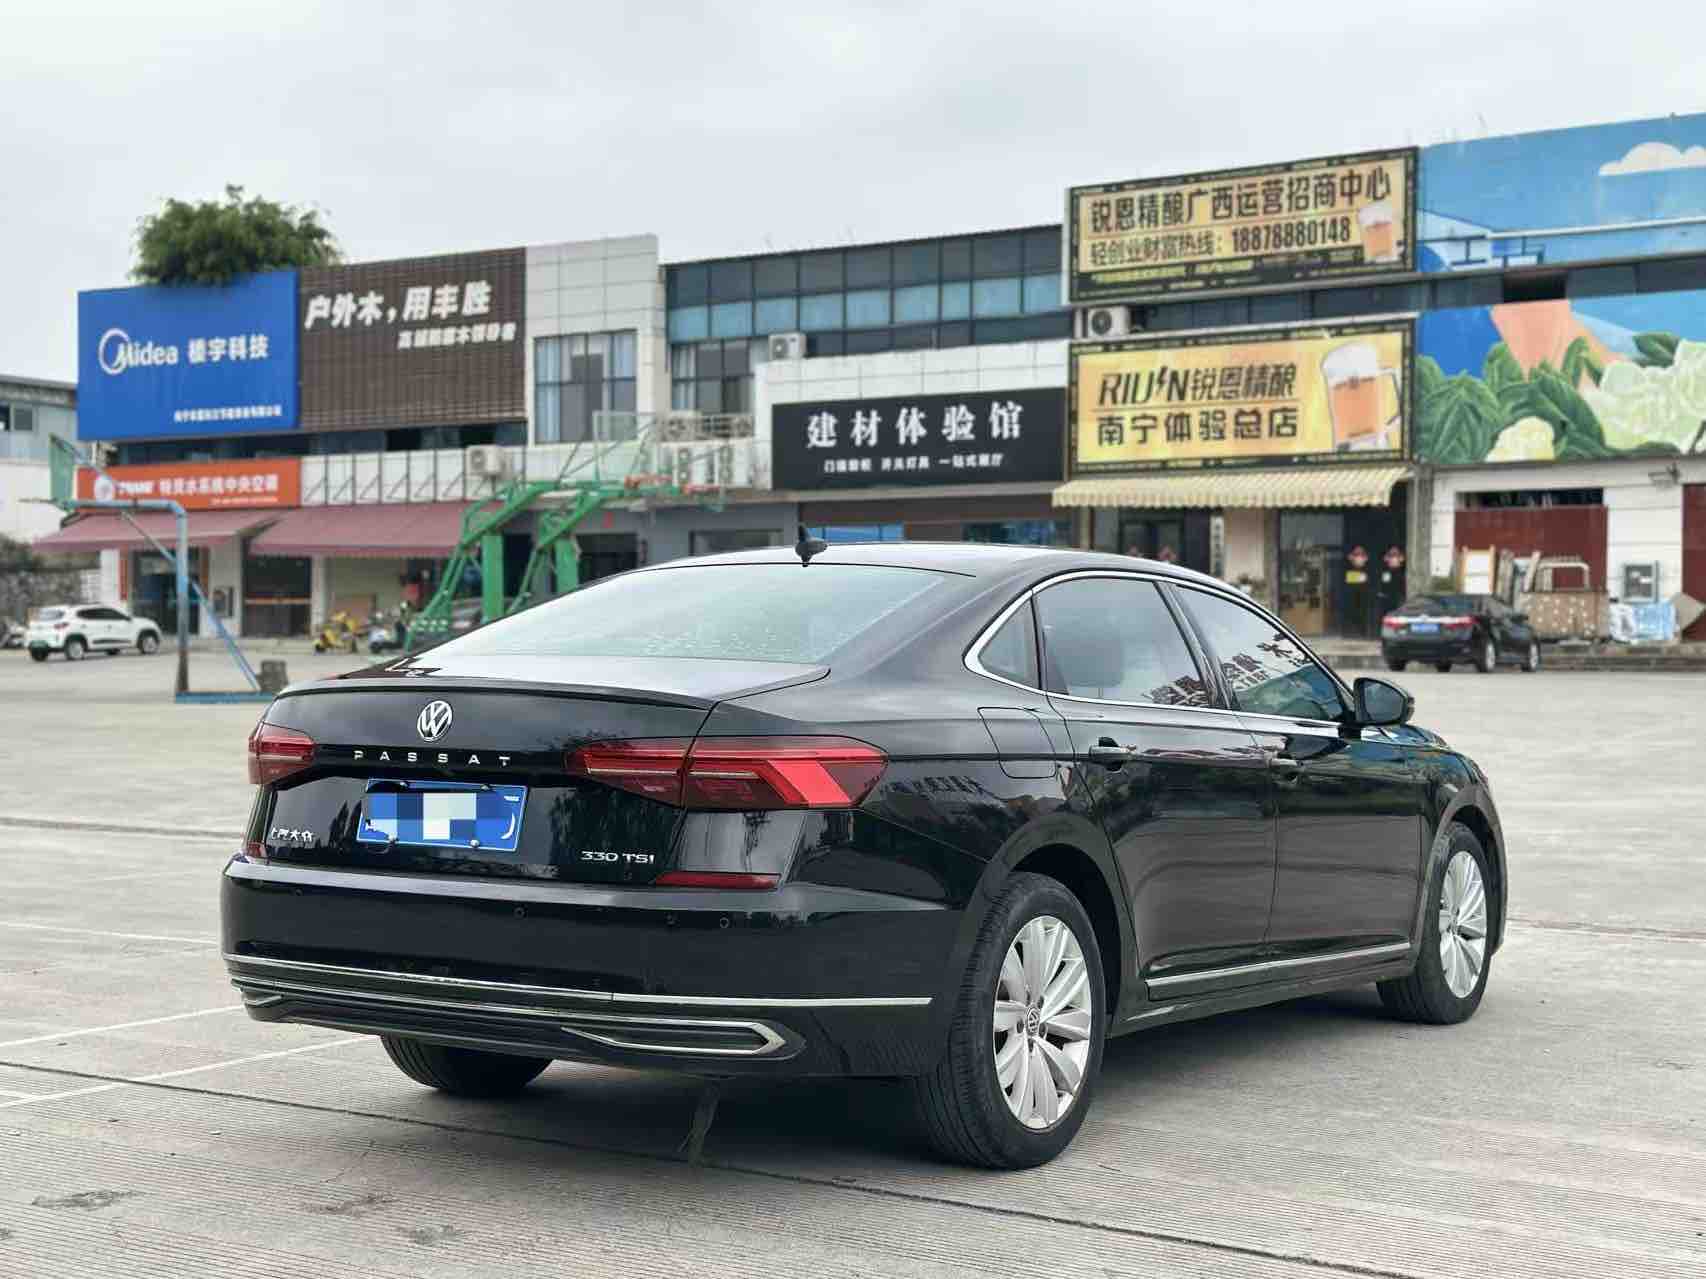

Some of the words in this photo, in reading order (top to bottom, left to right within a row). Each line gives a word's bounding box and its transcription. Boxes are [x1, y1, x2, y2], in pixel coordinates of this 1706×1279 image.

[1091, 166, 1391, 233] 锐恩精酿广西运营招商中心
[1231, 217, 1351, 253] 18878880148
[98, 328, 179, 376] Midea
[1191, 363, 1297, 400] 锐恩精酿
[806, 400, 1023, 449] 建材体验馆
[1097, 406, 1298, 446] 南宁体验总店
[353, 750, 511, 767] PASSAT
[581, 850, 619, 862] 330
[622, 853, 655, 864] TSI
